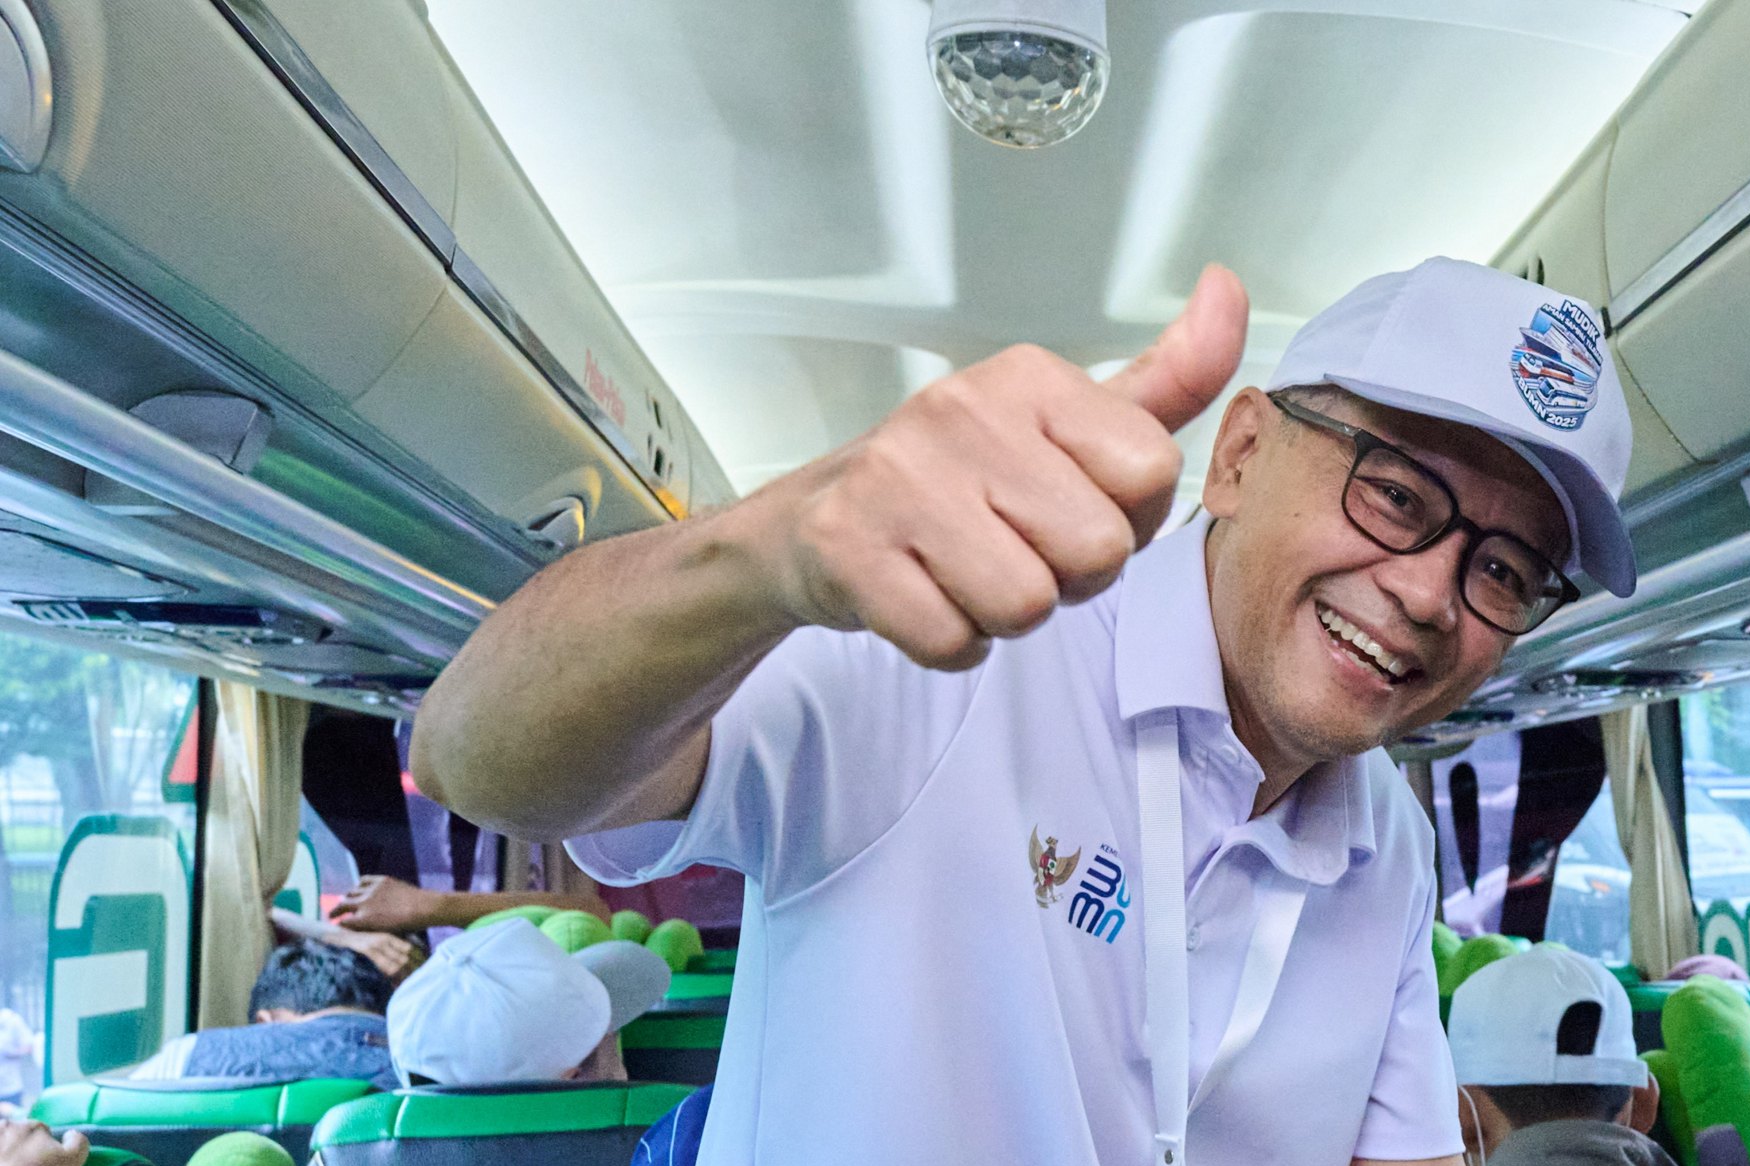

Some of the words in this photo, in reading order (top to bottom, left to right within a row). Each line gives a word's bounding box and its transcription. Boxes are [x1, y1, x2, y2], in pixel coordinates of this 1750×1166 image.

[1542, 304, 1565, 321] AMAN
[1562, 302, 1600, 340] MUDIK
[1518, 378, 1547, 418] BUMN
[1546, 413, 1578, 427] 2025
